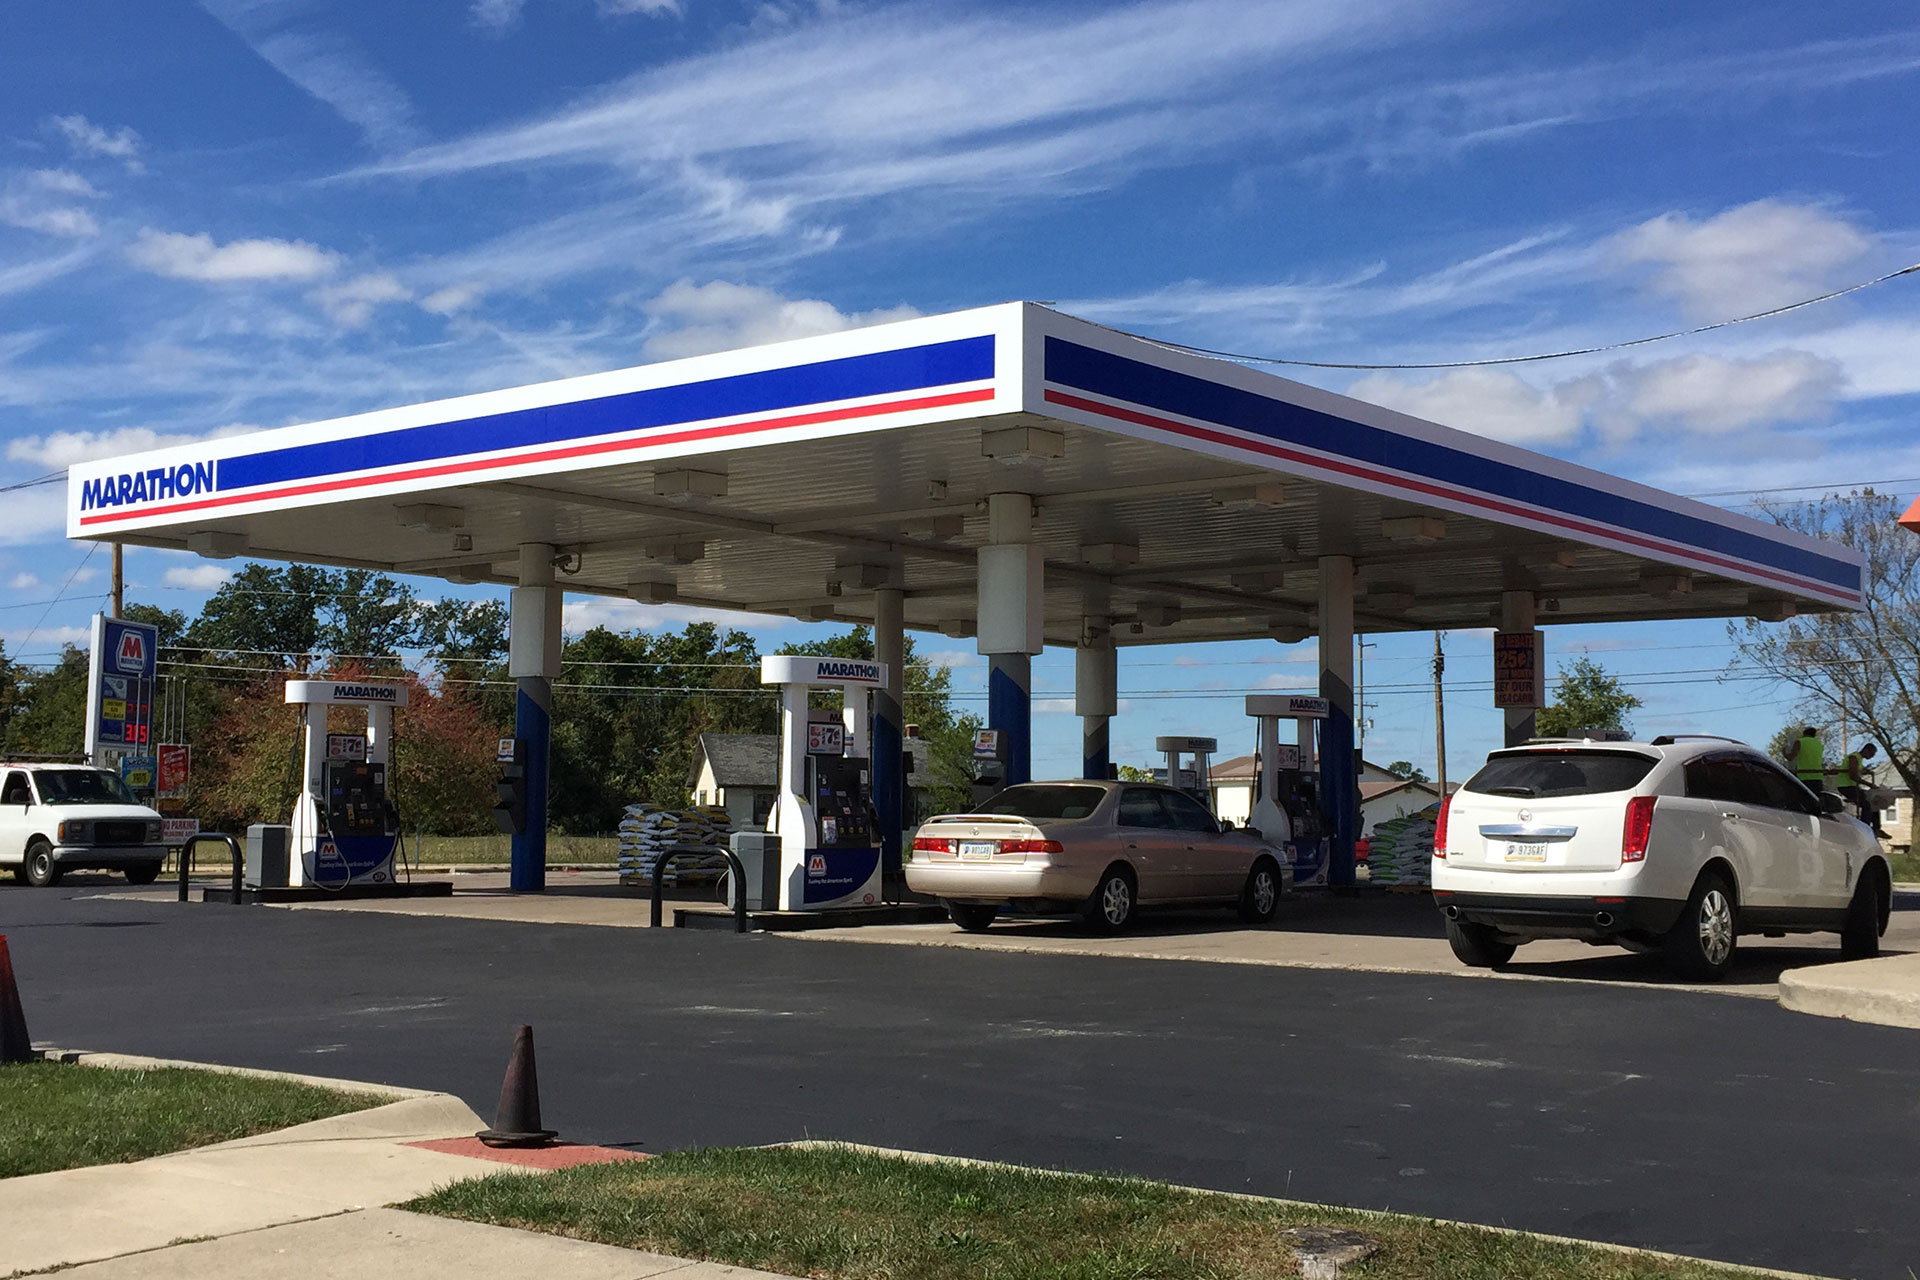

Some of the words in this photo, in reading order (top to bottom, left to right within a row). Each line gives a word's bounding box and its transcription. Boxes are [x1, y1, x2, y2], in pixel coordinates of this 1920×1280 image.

[80, 459, 214, 511] MARATHON
[121, 636, 142, 658] M
[817, 662, 880, 679] MARATHON
[333, 685, 397, 699] MARATHON
[1289, 698, 1328, 710] MARATHON
[171, 820, 197, 830] PARKING
[322, 844, 335, 854] M
[812, 858, 824, 869] M
